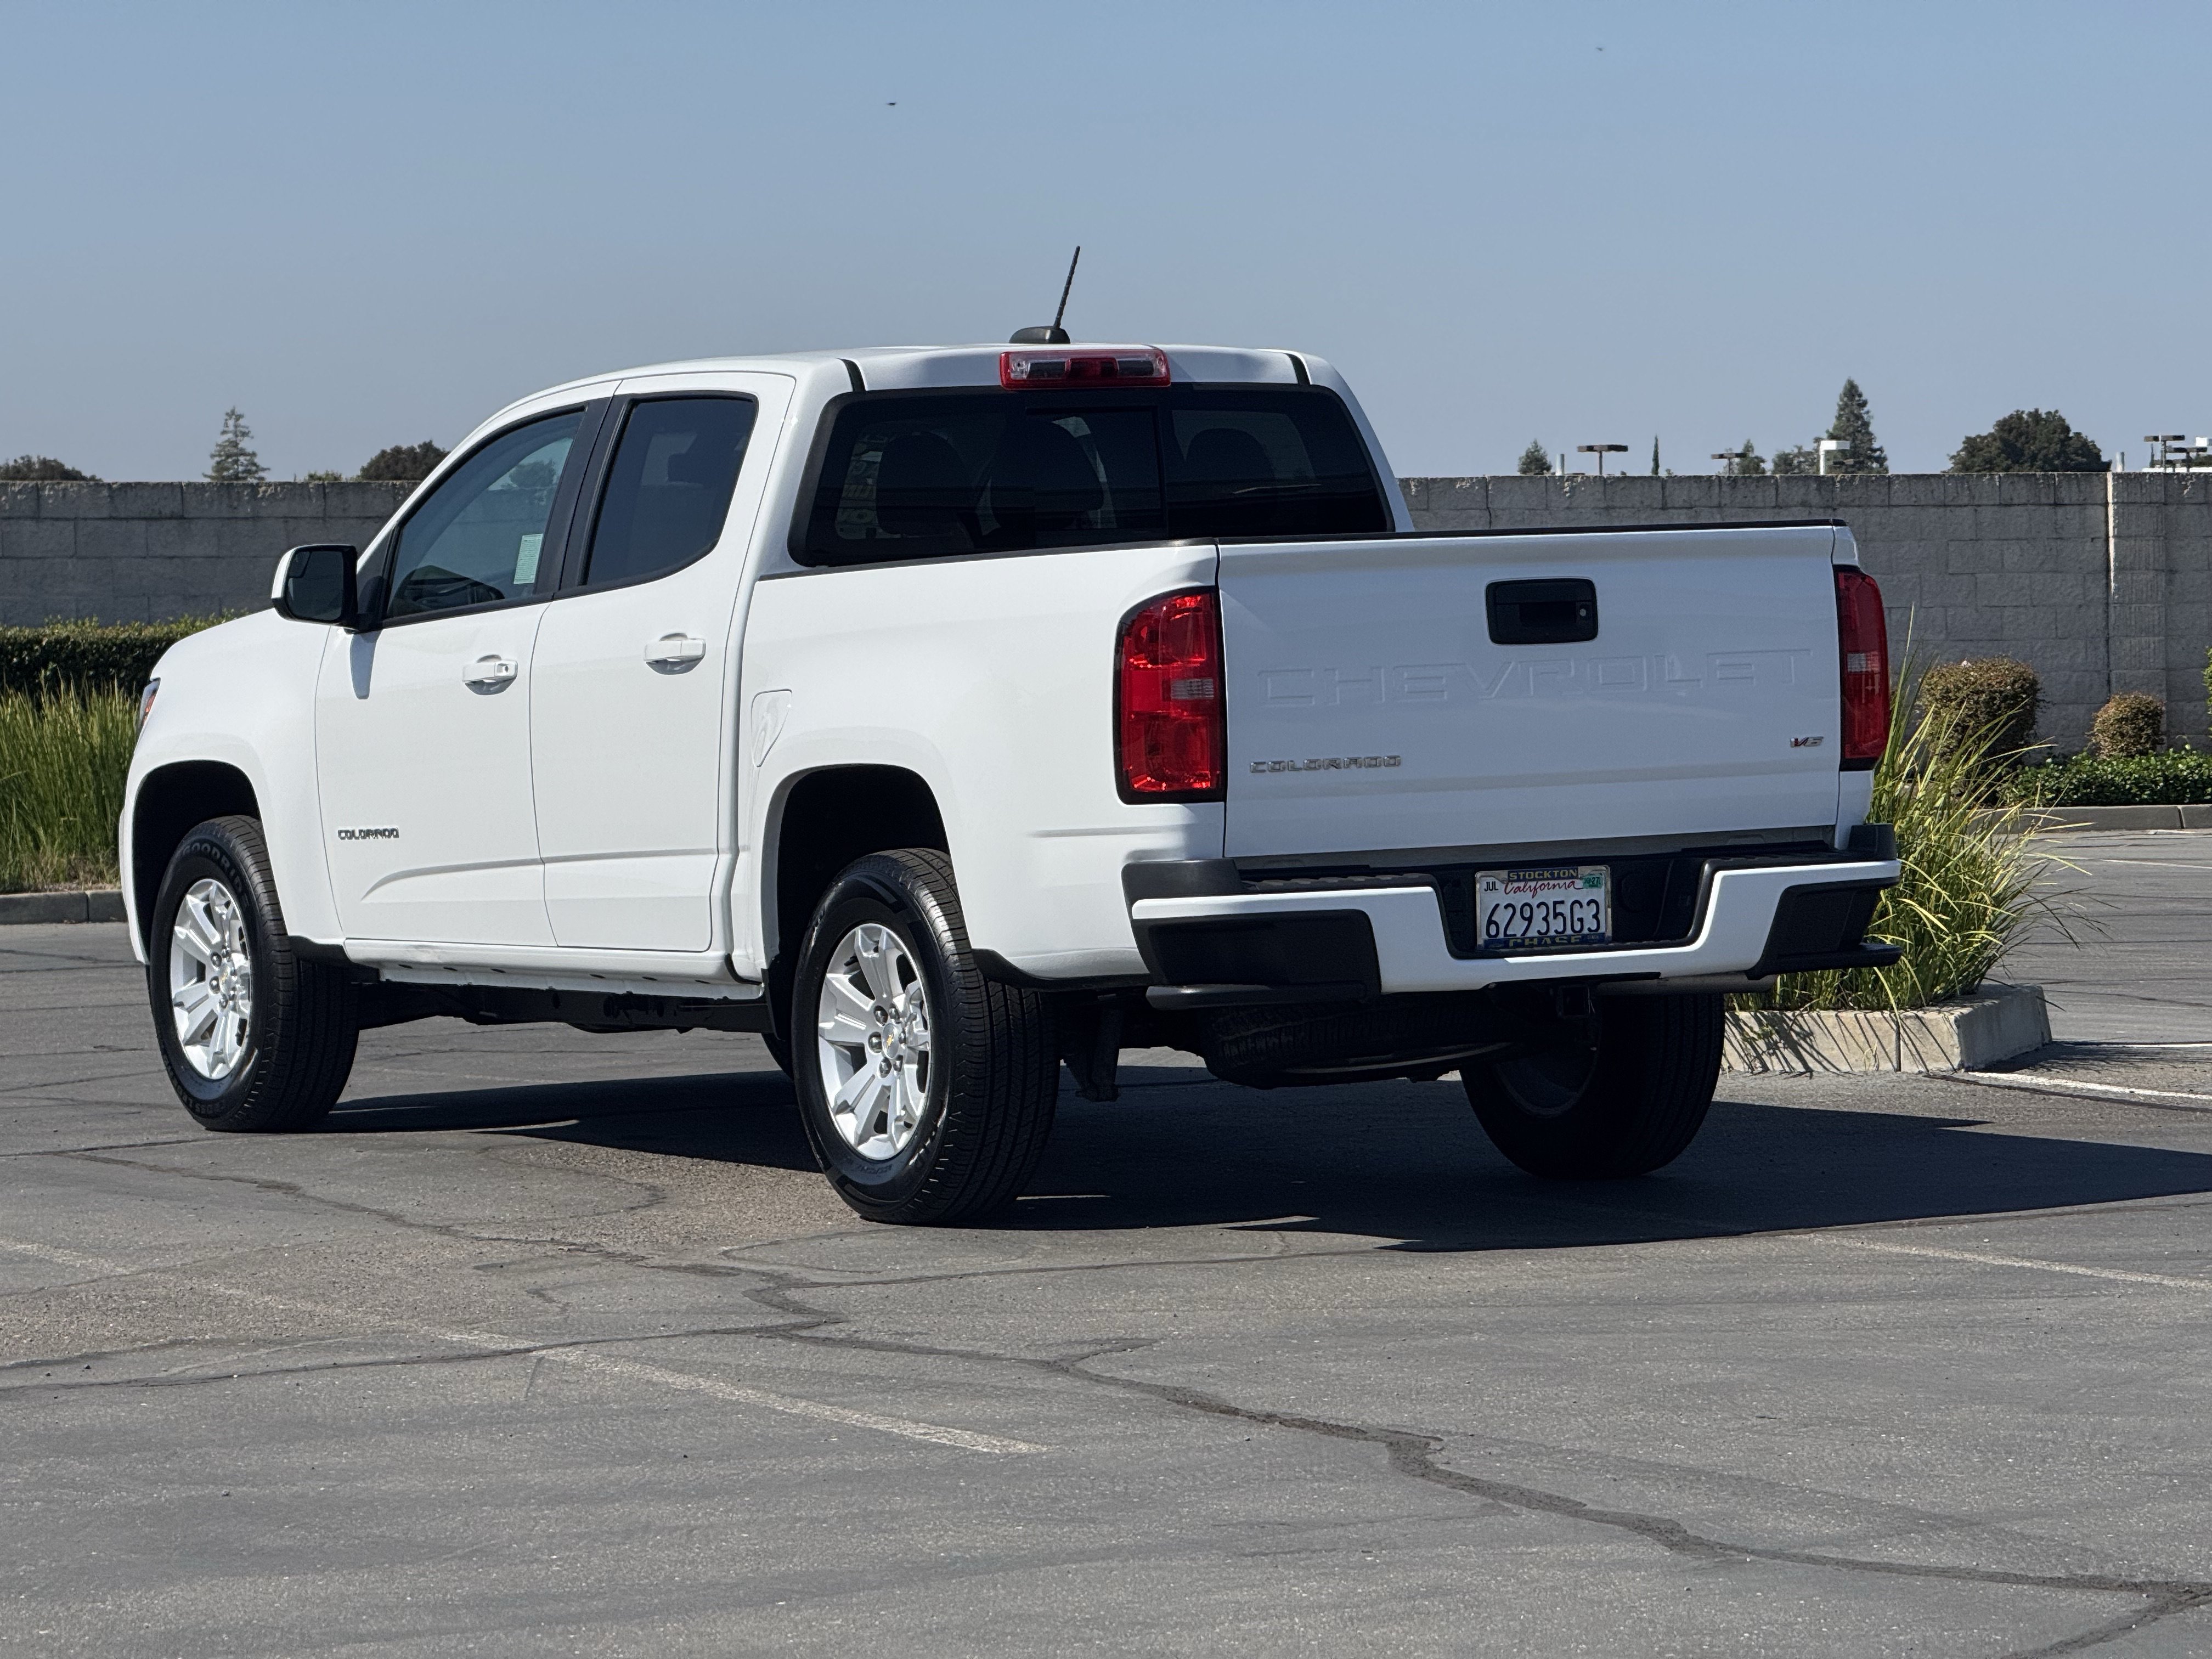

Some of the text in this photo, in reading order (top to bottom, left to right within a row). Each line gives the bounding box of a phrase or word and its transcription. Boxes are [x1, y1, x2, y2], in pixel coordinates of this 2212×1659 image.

[1257, 649, 1810, 707] CHEVROLET
[1790, 736, 1824, 748] V6
[1250, 755, 1401, 773] COLORADO
[337, 827, 399, 840] COLORADO
[1509, 869, 1577, 880] STOCKTON
[1484, 881, 1499, 891] JUL
[1504, 881, 1584, 898] California
[1486, 899, 1601, 938] 62935G3
